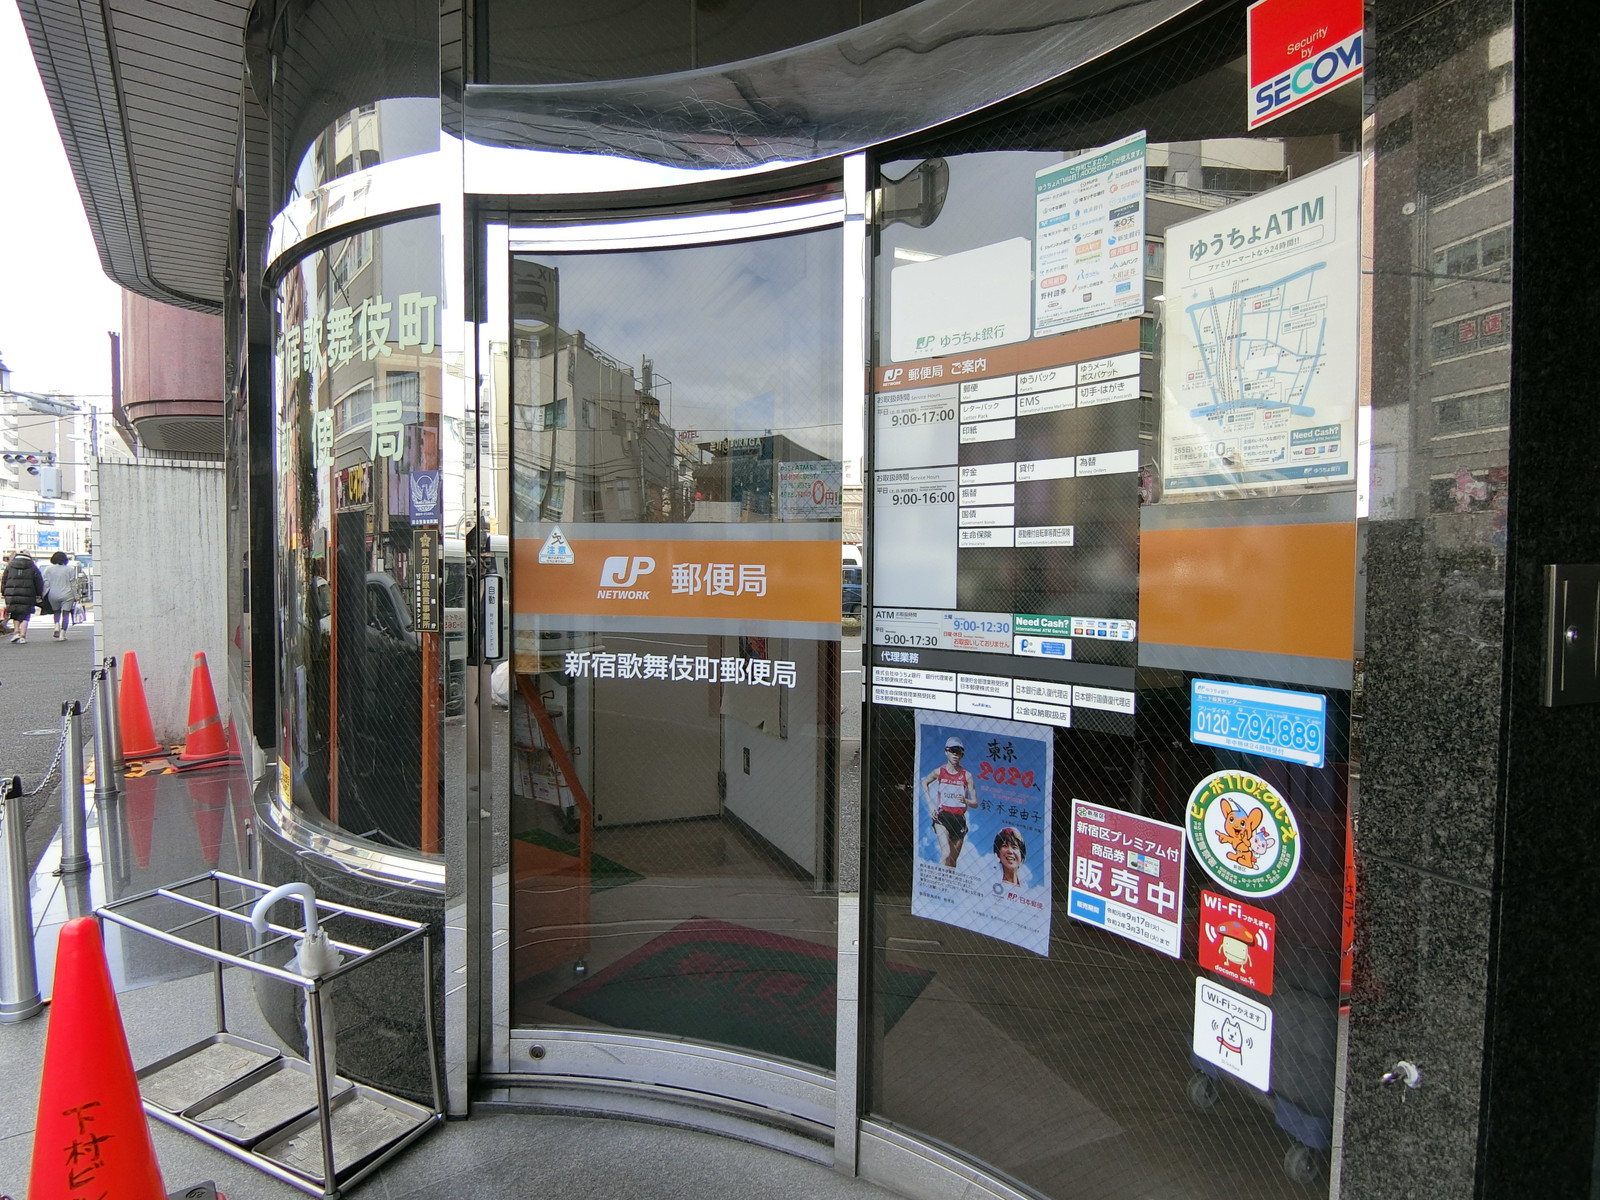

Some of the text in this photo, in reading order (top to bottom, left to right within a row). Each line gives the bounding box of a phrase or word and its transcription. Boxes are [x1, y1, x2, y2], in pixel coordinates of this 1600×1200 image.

[1286, 26, 1328, 55] Security
[1301, 46, 1313, 58] by
[1256, 35, 1361, 115] SECOM
[1189, 196, 1324, 261] ゆうちょATM
[1208, 237, 1300, 272] ファミリーマートなら24時間!!
[940, 324, 1006, 348] ゆうちょ銀行
[908, 364, 943, 381] 郵便局
[951, 358, 987, 375] ご案内
[1080, 360, 1114, 372] ゆうメール
[963, 383, 978, 393] 郵便
[877, 393, 910, 404] お取扱時間
[1019, 396, 1040, 408] EMS
[891, 409, 955, 427] 9:00-17:00
[678, 431, 699, 439] HOTEL
[962, 426, 978, 435] 印紙
[1293, 427, 1339, 440] Need Cash?
[1019, 463, 1035, 472] 貸付
[1079, 457, 1096, 467] 為替
[876, 473, 910, 482] お取扱時間
[962, 468, 977, 477] 貯金
[892, 491, 955, 505] 9:00-16:00
[962, 489, 977, 498] 振替
[962, 510, 977, 518] 国債
[962, 531, 992, 539] 生命保険
[547, 545, 566, 554] 注意
[671, 563, 767, 598] 郵便局
[597, 590, 650, 600] NETWORK
[875, 611, 895, 619] ATM
[953, 620, 1010, 633] 9:00-12:30
[1016, 616, 1069, 628] Need Cash?
[884, 634, 938, 646] 9:00-17:30
[881, 650, 919, 664] 代理業務
[564, 650, 797, 689] 新宿歌舞伎町郵便局
[875, 676, 913, 685] 日本郵便株式会社
[960, 685, 1000, 693] 日本郵便株式会社
[875, 695, 913, 703] 日本郵便株式会社
[1016, 706, 1066, 721] 公金収納取扱店
[1197, 711, 1320, 753] 0120-794889
[986, 739, 1018, 763] 東京
[980, 799, 1042, 823] 鈴木亜由子
[1076, 821, 1179, 863] 新宿区プレミアム付
[1091, 842, 1125, 864] 商品券
[1075, 856, 1175, 915] 販売中
[1215, 965, 1239, 978] docomo
[1207, 991, 1261, 1022] Wi-Fiつかえます
[62, 1101, 116, 1200] 下村ビ
